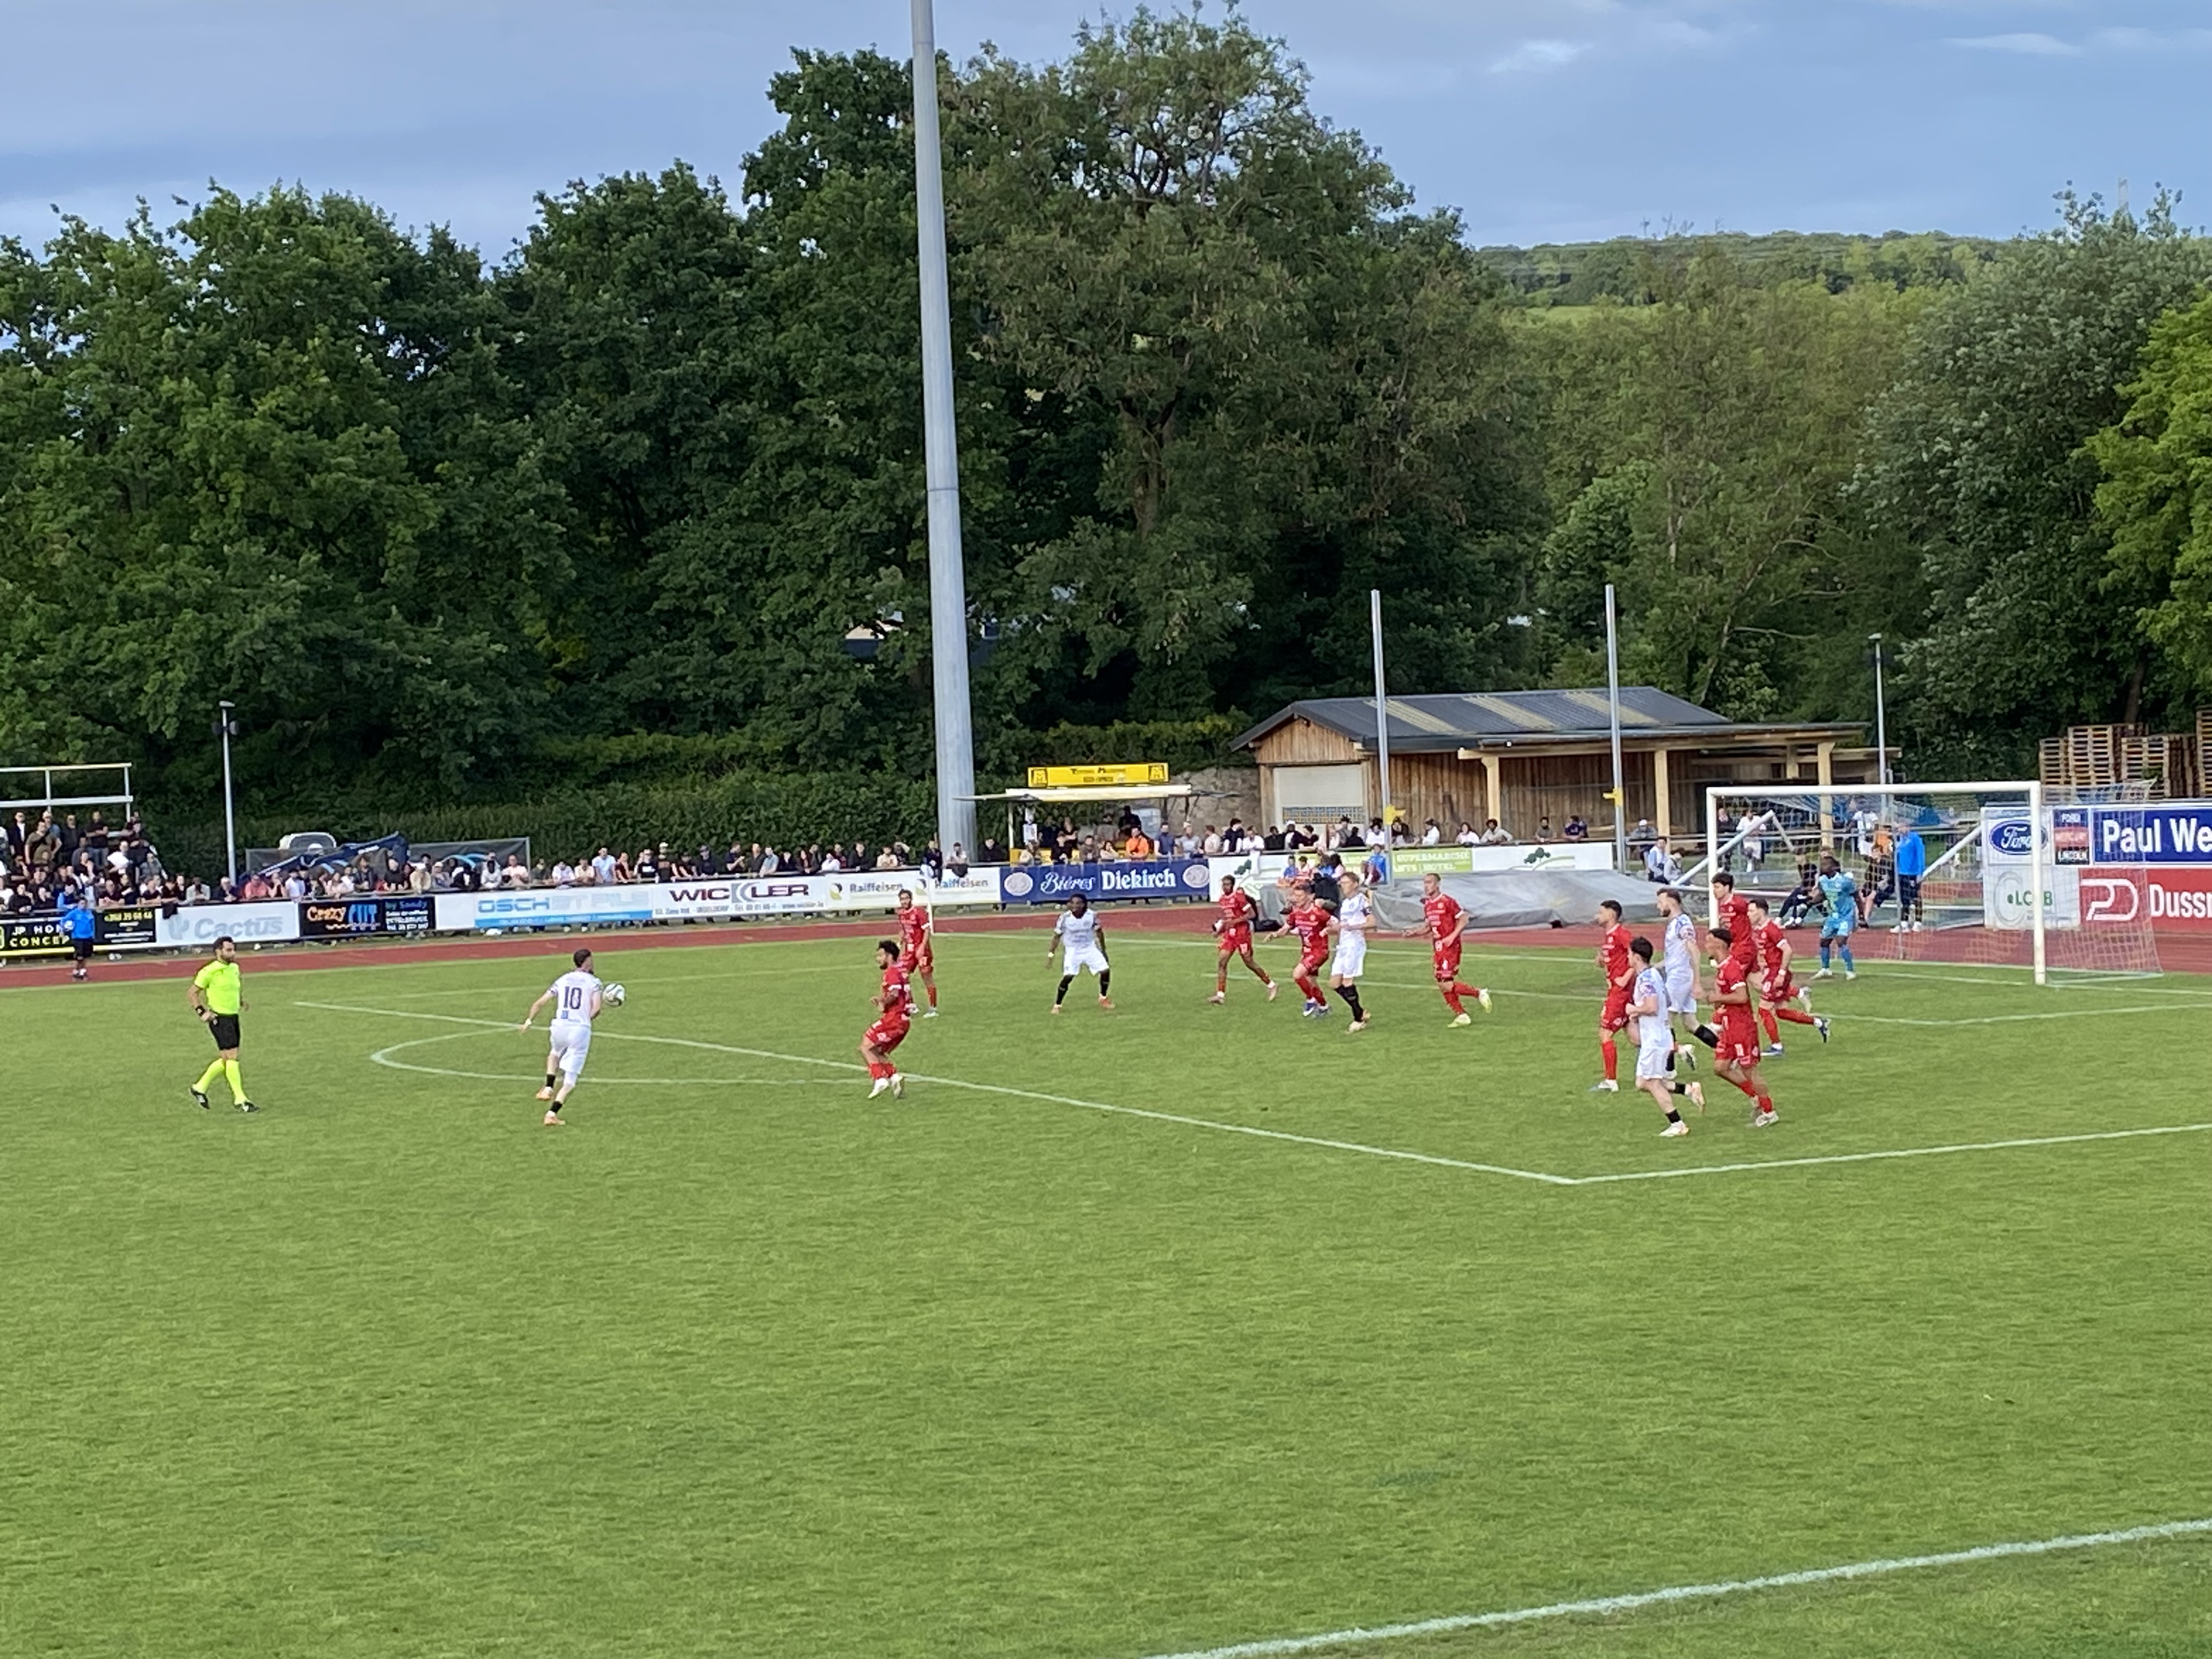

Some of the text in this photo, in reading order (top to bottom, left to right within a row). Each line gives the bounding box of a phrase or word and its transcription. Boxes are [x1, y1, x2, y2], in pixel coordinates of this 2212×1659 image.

[2103, 817, 2212, 853] Paul We
[1102, 868, 1176, 890] Diekirch
[669, 881, 809, 902] WICKLER
[307, 906, 346, 922] Crazy
[478, 898, 550, 913] OSCH
[195, 917, 283, 939] Cactus
[9, 935, 70, 947] CONCEP
[563, 986, 582, 1009] 10
